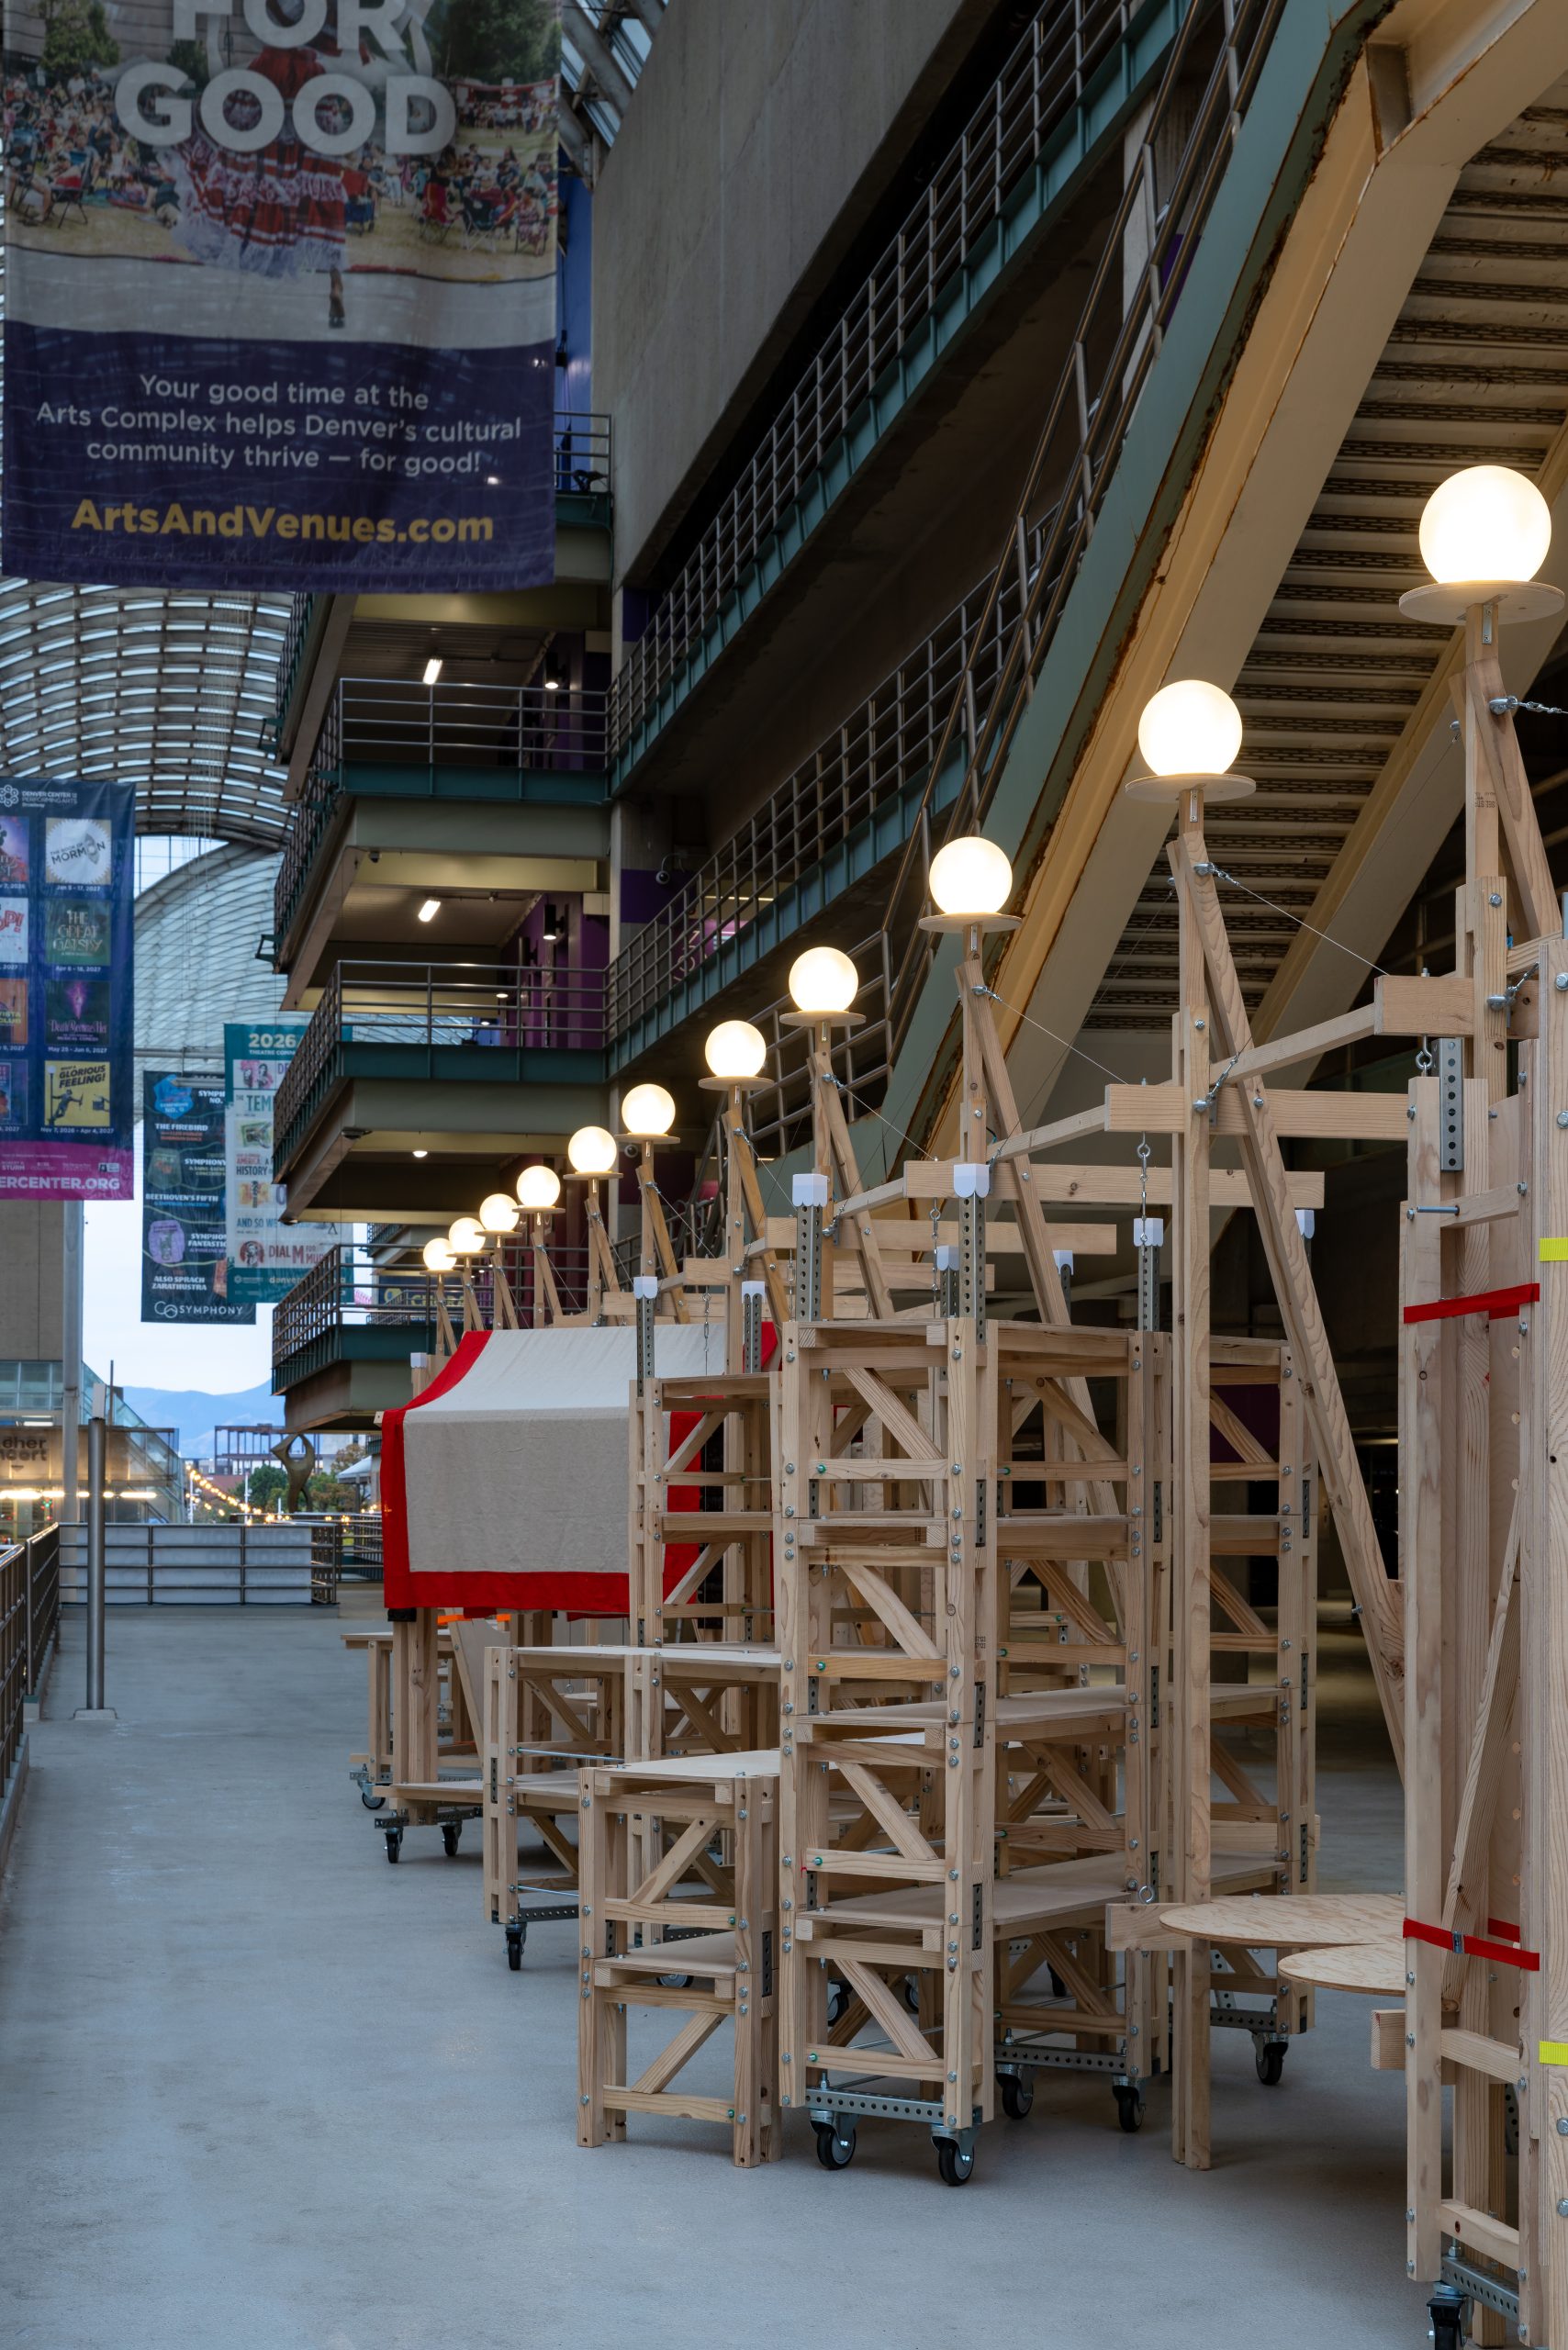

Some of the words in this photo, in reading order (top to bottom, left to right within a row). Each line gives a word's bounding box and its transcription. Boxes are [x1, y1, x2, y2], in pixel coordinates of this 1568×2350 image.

[173, 0, 407, 50] FOR
[114, 62, 456, 155] GOOD
[140, 375, 200, 399] Your
[208, 381, 278, 406] good
[287, 382, 345, 405] time
[353, 385, 380, 406] at
[388, 386, 429, 410] the
[36, 401, 92, 426] Arts
[100, 406, 217, 432] Complex
[226, 411, 296, 439] helps
[305, 415, 417, 442] Denver's
[425, 416, 521, 442] cultural
[86, 442, 235, 469] community
[243, 444, 319, 467] thrive
[359, 447, 397, 472] for
[404, 451, 480, 477] good!
[71, 498, 494, 543] ArtsAndVenues.com
[51, 840, 106, 864] MORMON
[66, 910, 89, 924] THE
[58, 924, 99, 938] GREAT
[52, 938, 103, 952] GATSBY
[59, 1065, 106, 1080] GLORIOUS
[59, 1073, 106, 1089] FEELING!
[236, 1166, 267, 1176] HISTORY
[0, 1176, 120, 1190] ERCENTER.ORG
[237, 1218, 252, 1228] AND
[254, 1218, 264, 1228] SO
[269, 1245, 291, 1258] DIAL
[293, 1245, 304, 1264] M
[154, 1275, 174, 1283] ALSO
[179, 1305, 243, 1315] SYMPHONY
